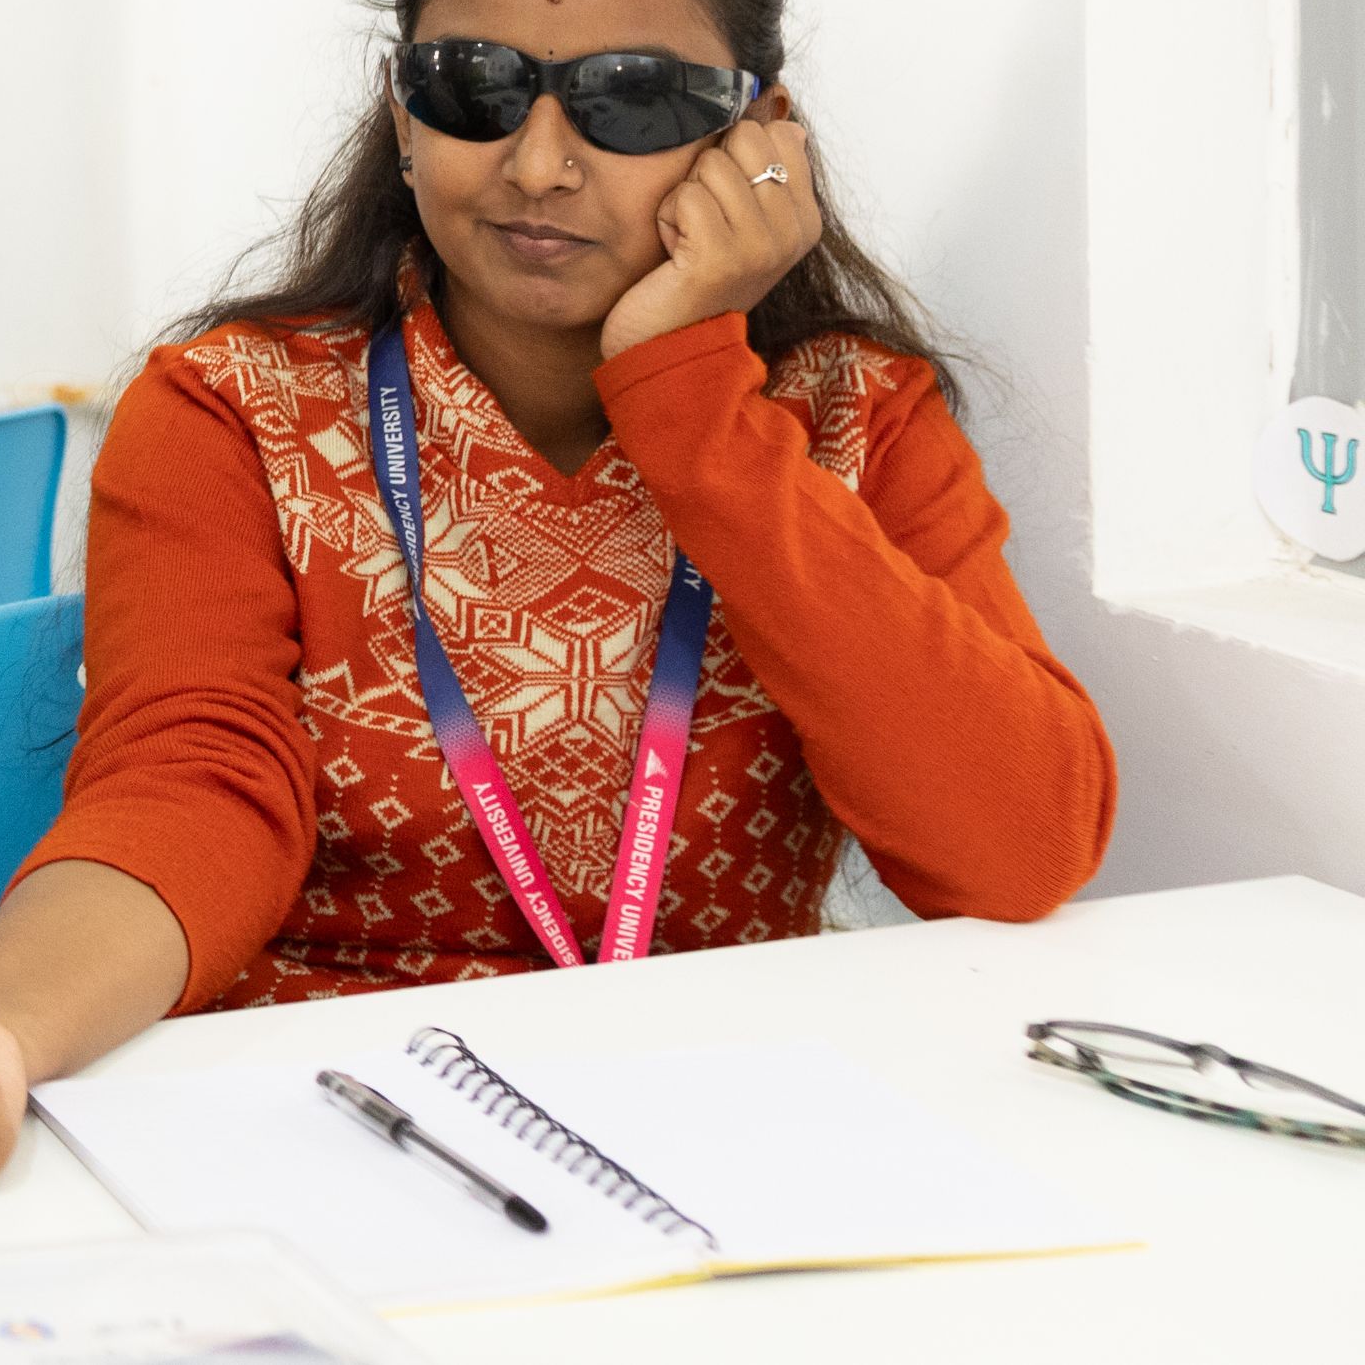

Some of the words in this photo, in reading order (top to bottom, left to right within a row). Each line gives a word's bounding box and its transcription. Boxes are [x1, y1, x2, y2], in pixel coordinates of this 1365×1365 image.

[380, 386, 408, 485] UNIVERSITY
[471, 781, 536, 889] UNIVERSITY
[624, 784, 665, 902] PRESIDENCY
[611, 903, 643, 963] UNIVE
